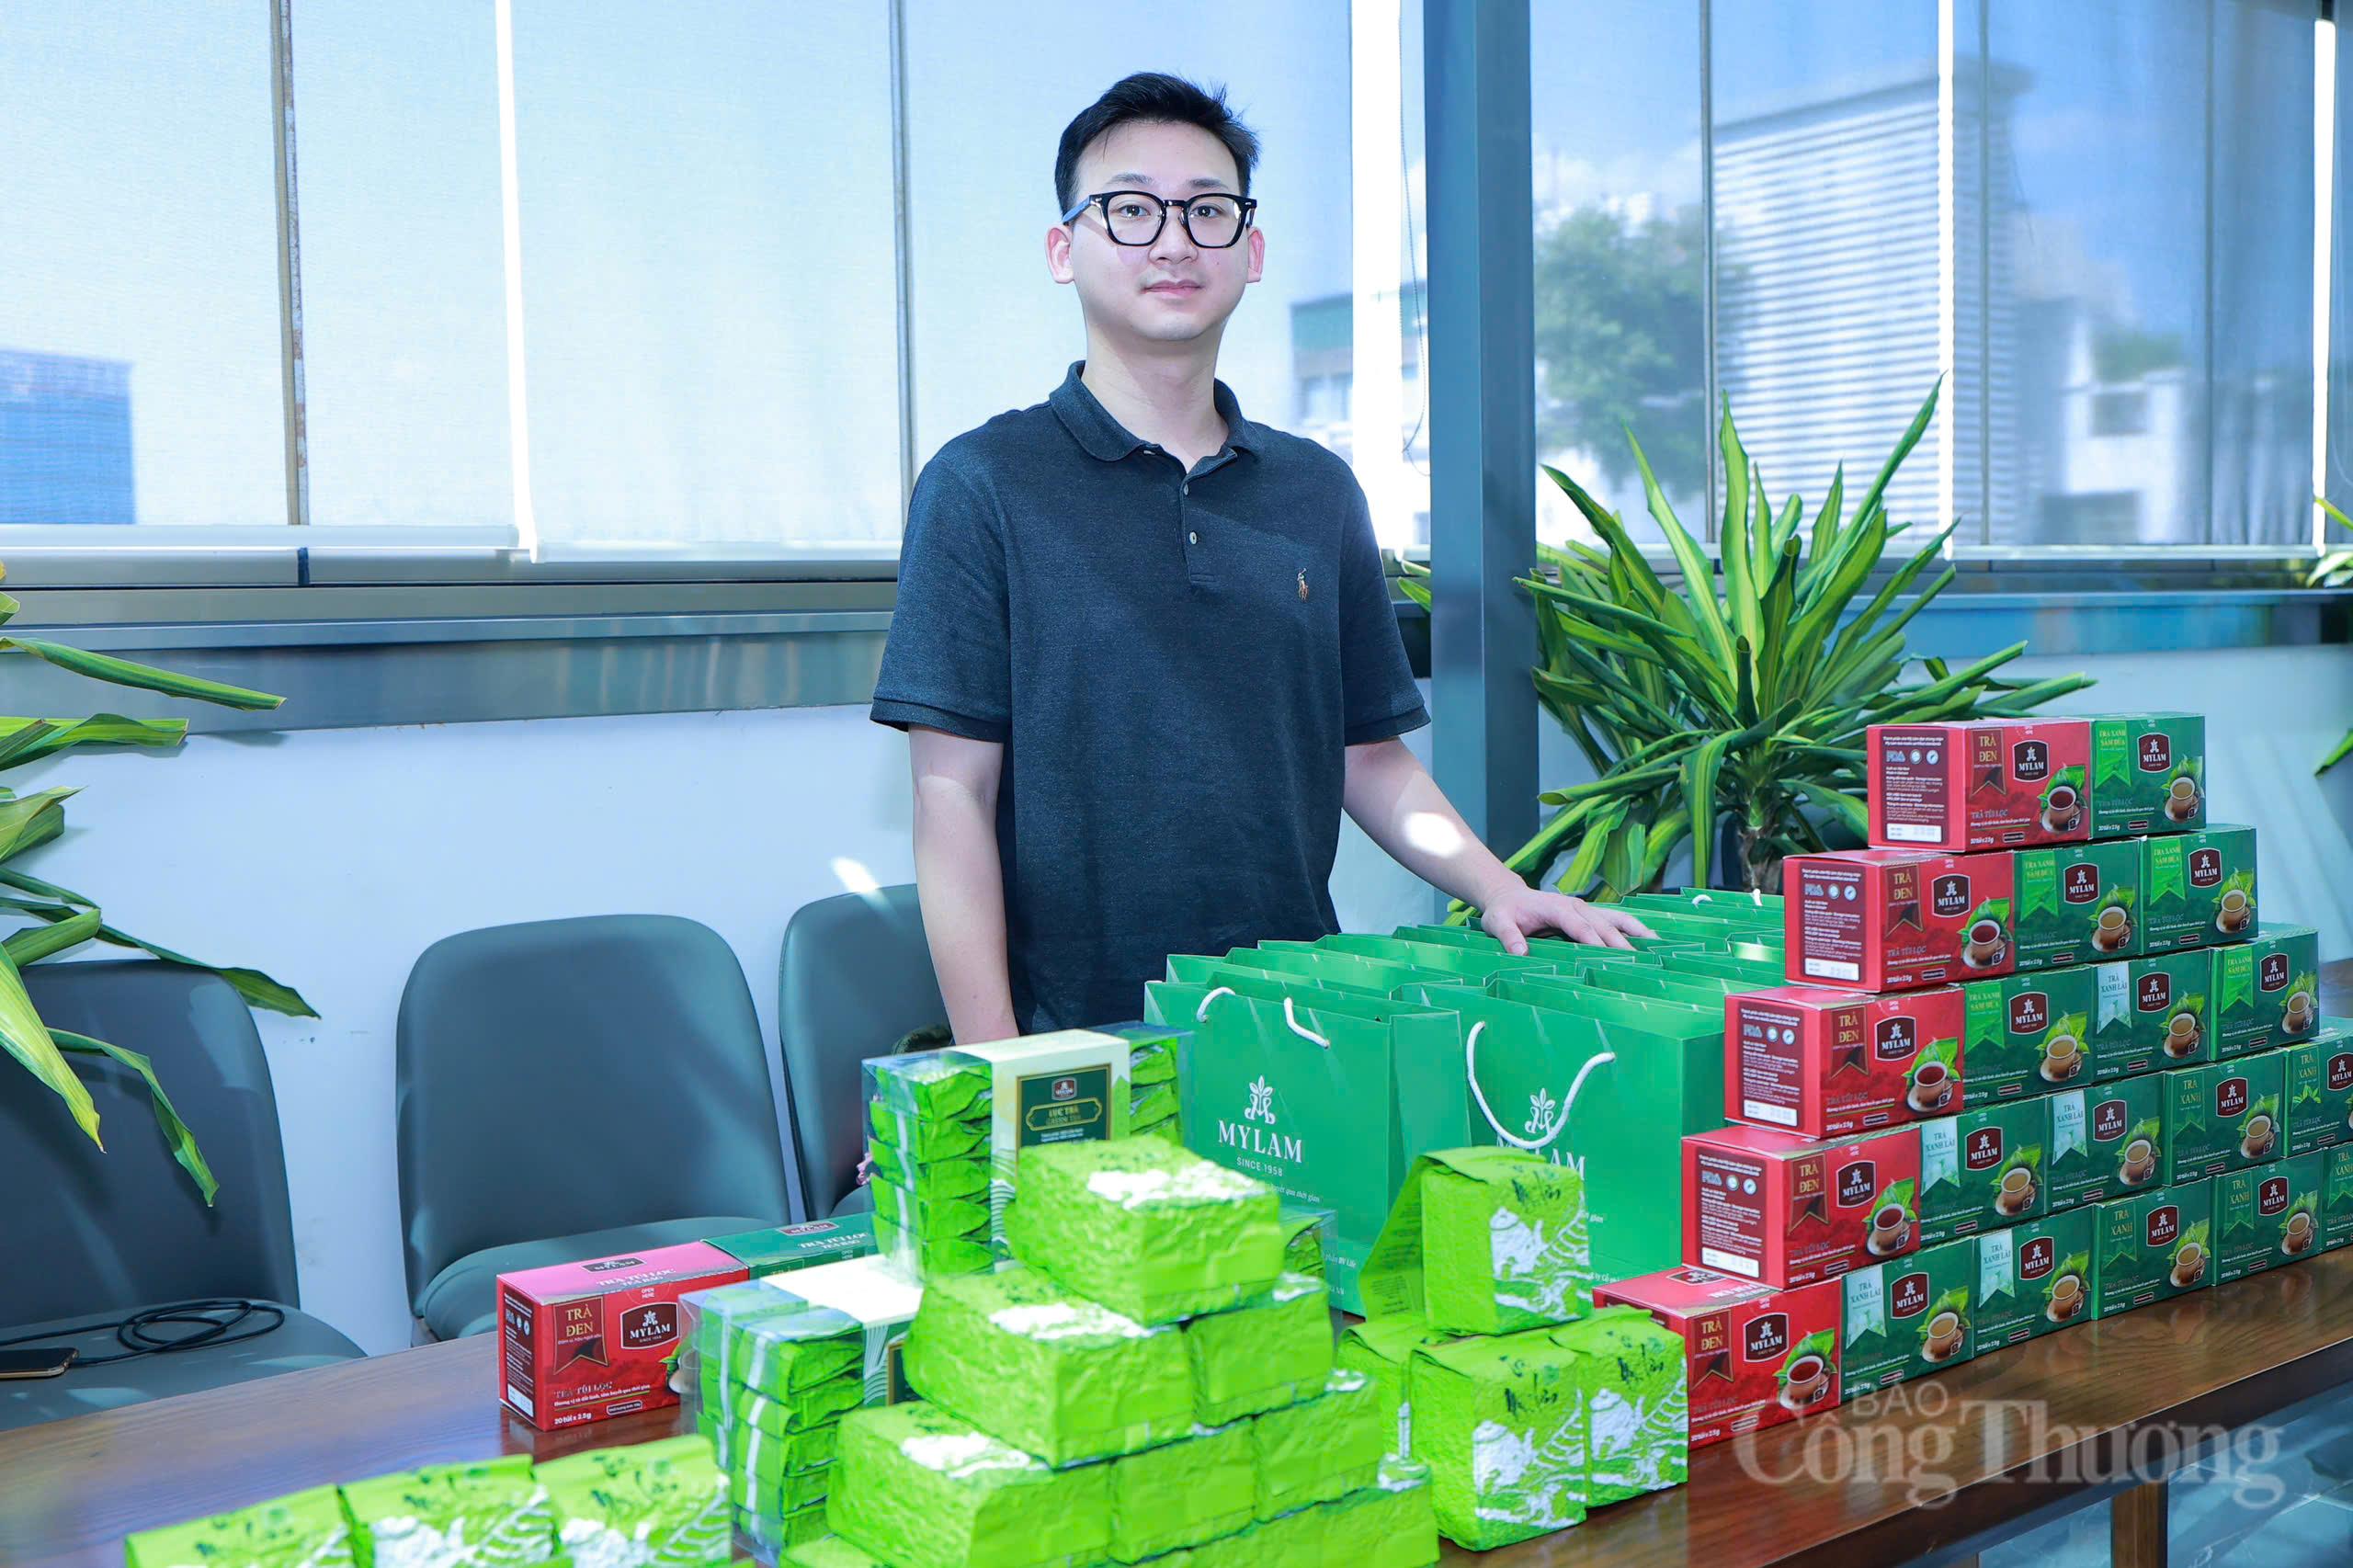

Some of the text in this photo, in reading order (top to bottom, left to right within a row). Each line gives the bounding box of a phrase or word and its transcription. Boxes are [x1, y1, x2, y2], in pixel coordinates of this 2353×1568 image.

[1979, 732, 1996, 747] TRÀ
[1979, 750, 1997, 762] ĐEN
[2143, 754, 2166, 763] MYLAM
[2018, 761, 2044, 772] MYLAM
[1893, 869, 1912, 884] TRÀ
[2194, 868, 2218, 878] MYLAM
[1893, 887, 1914, 900] ĐEN
[2069, 883, 2095, 894] MYLAM
[1938, 895, 1965, 907] MYLAM
[2264, 971, 2285, 983] MYLAM
[2142, 992, 2166, 1003] MYLAM
[1838, 1012, 1858, 1027] TRÀ
[2015, 1013, 2043, 1025] MYLAM
[1838, 1029, 1859, 1043] ĐEN
[1881, 1039, 1911, 1051] MYLAM
[2332, 1071, 2352, 1082] MYLAM
[2221, 1096, 2244, 1108] MYLAM
[2098, 1119, 2122, 1132] MYLAM
[1218, 1119, 1302, 1164] MYLAM
[1970, 1147, 1998, 1161] MYLAM
[1236, 1156, 1283, 1176] SINCE 1958
[1799, 1162, 1818, 1176] TRÀ
[1799, 1179, 1820, 1193] ĐEN
[1842, 1183, 1870, 1197] MYLAM
[2263, 1195, 2285, 1207] MYLAM
[2151, 1224, 2175, 1238] MYLAM
[2024, 1256, 2050, 1270] MYLAM
[1896, 1293, 1924, 1309] MYLAM
[565, 1303, 593, 1322] TRÀ
[566, 1323, 594, 1337] ĐEN
[630, 1324, 671, 1340] MYLAM
[1701, 1319, 1722, 1334] TRÀ
[1701, 1336, 1723, 1350] ĐEN
[1750, 1335, 1782, 1352] MYLAM
[574, 1383, 591, 1393] TÚI
[563, 1415, 573, 1424] túi
